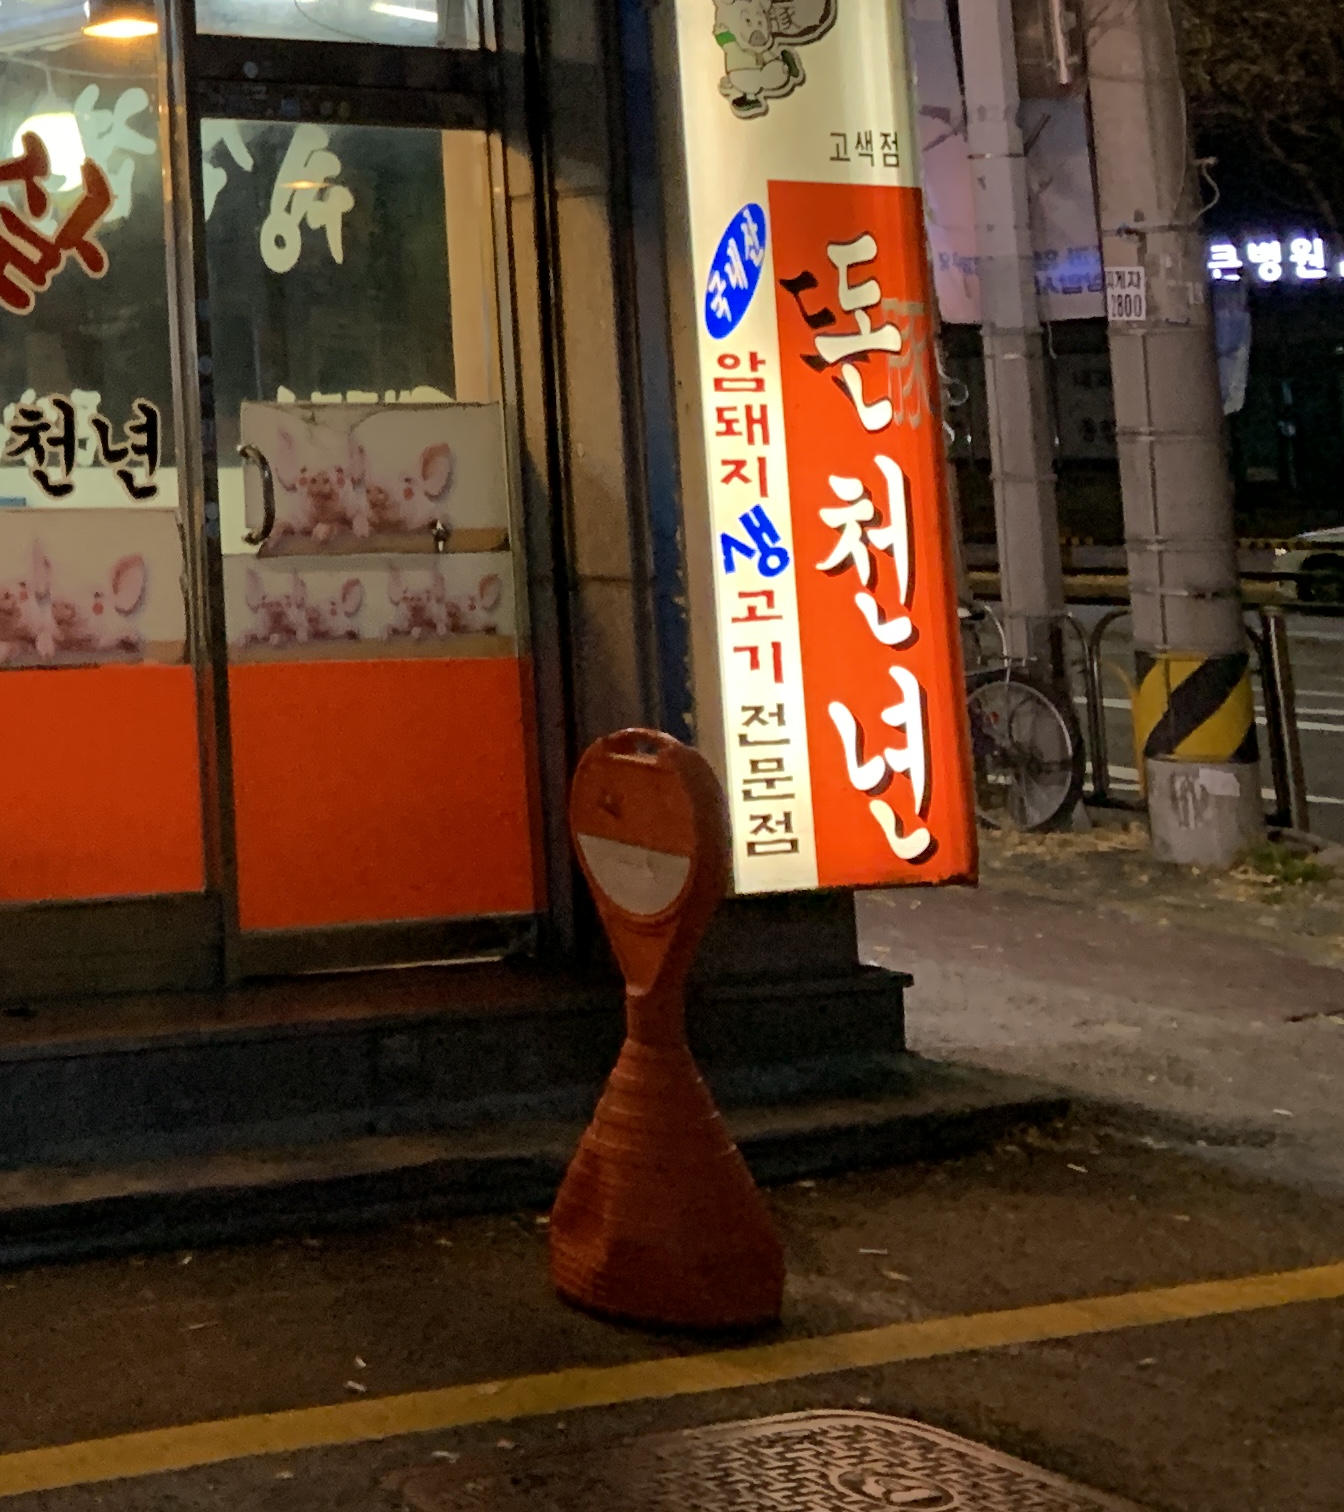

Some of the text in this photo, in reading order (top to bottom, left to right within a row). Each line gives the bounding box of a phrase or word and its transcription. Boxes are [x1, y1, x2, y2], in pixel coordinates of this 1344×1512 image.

[828, 129, 901, 169] 고색점
[706, 208, 768, 324] 국내산
[739, 703, 801, 857] 전문점
